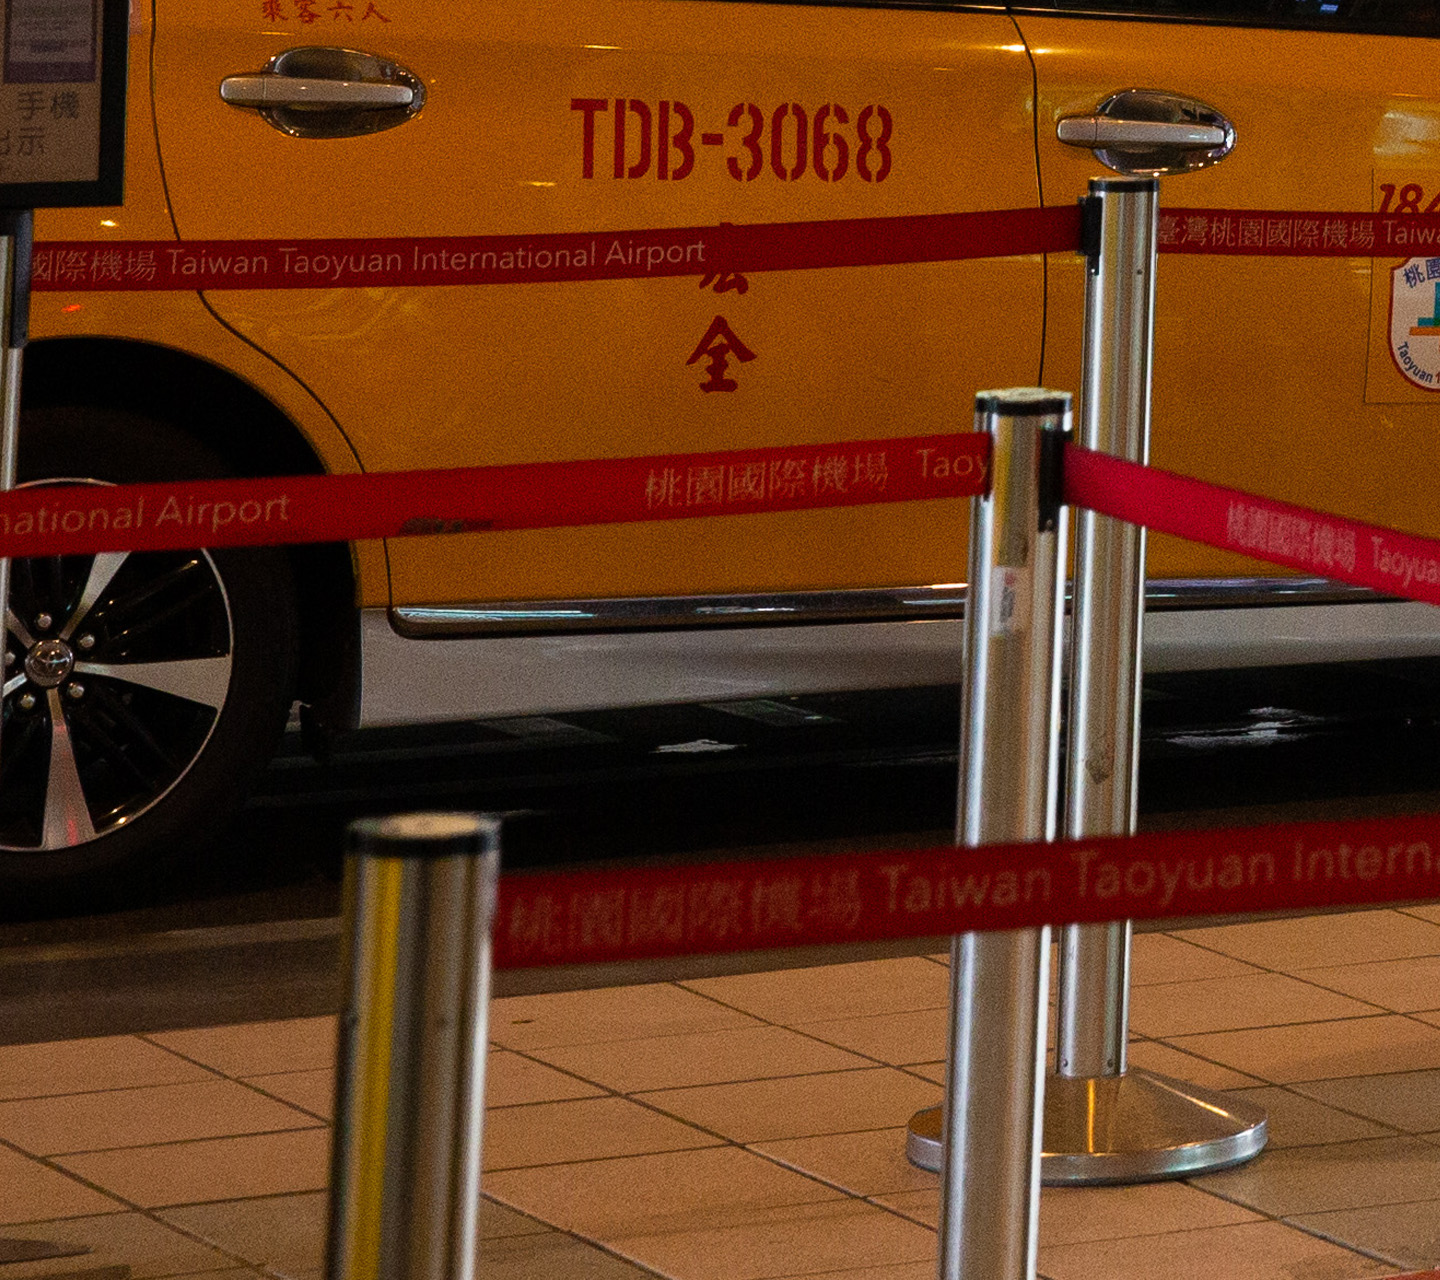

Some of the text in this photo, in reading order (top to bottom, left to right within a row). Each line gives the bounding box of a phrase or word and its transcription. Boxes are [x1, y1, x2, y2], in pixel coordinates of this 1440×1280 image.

[17, 91, 79, 120] 手機
[570, 98, 893, 184] TDB-3068
[166, 247, 270, 276] Taiwan
[277, 246, 403, 281] Taoyuan
[412, 239, 598, 273] International
[603, 238, 707, 271] Airport
[1397, 341, 1433, 384] Taoyuan
[154, 494, 291, 534] Airport
[878, 861, 1053, 914] Taiwan
[1070, 848, 1276, 907] Taoyuan
